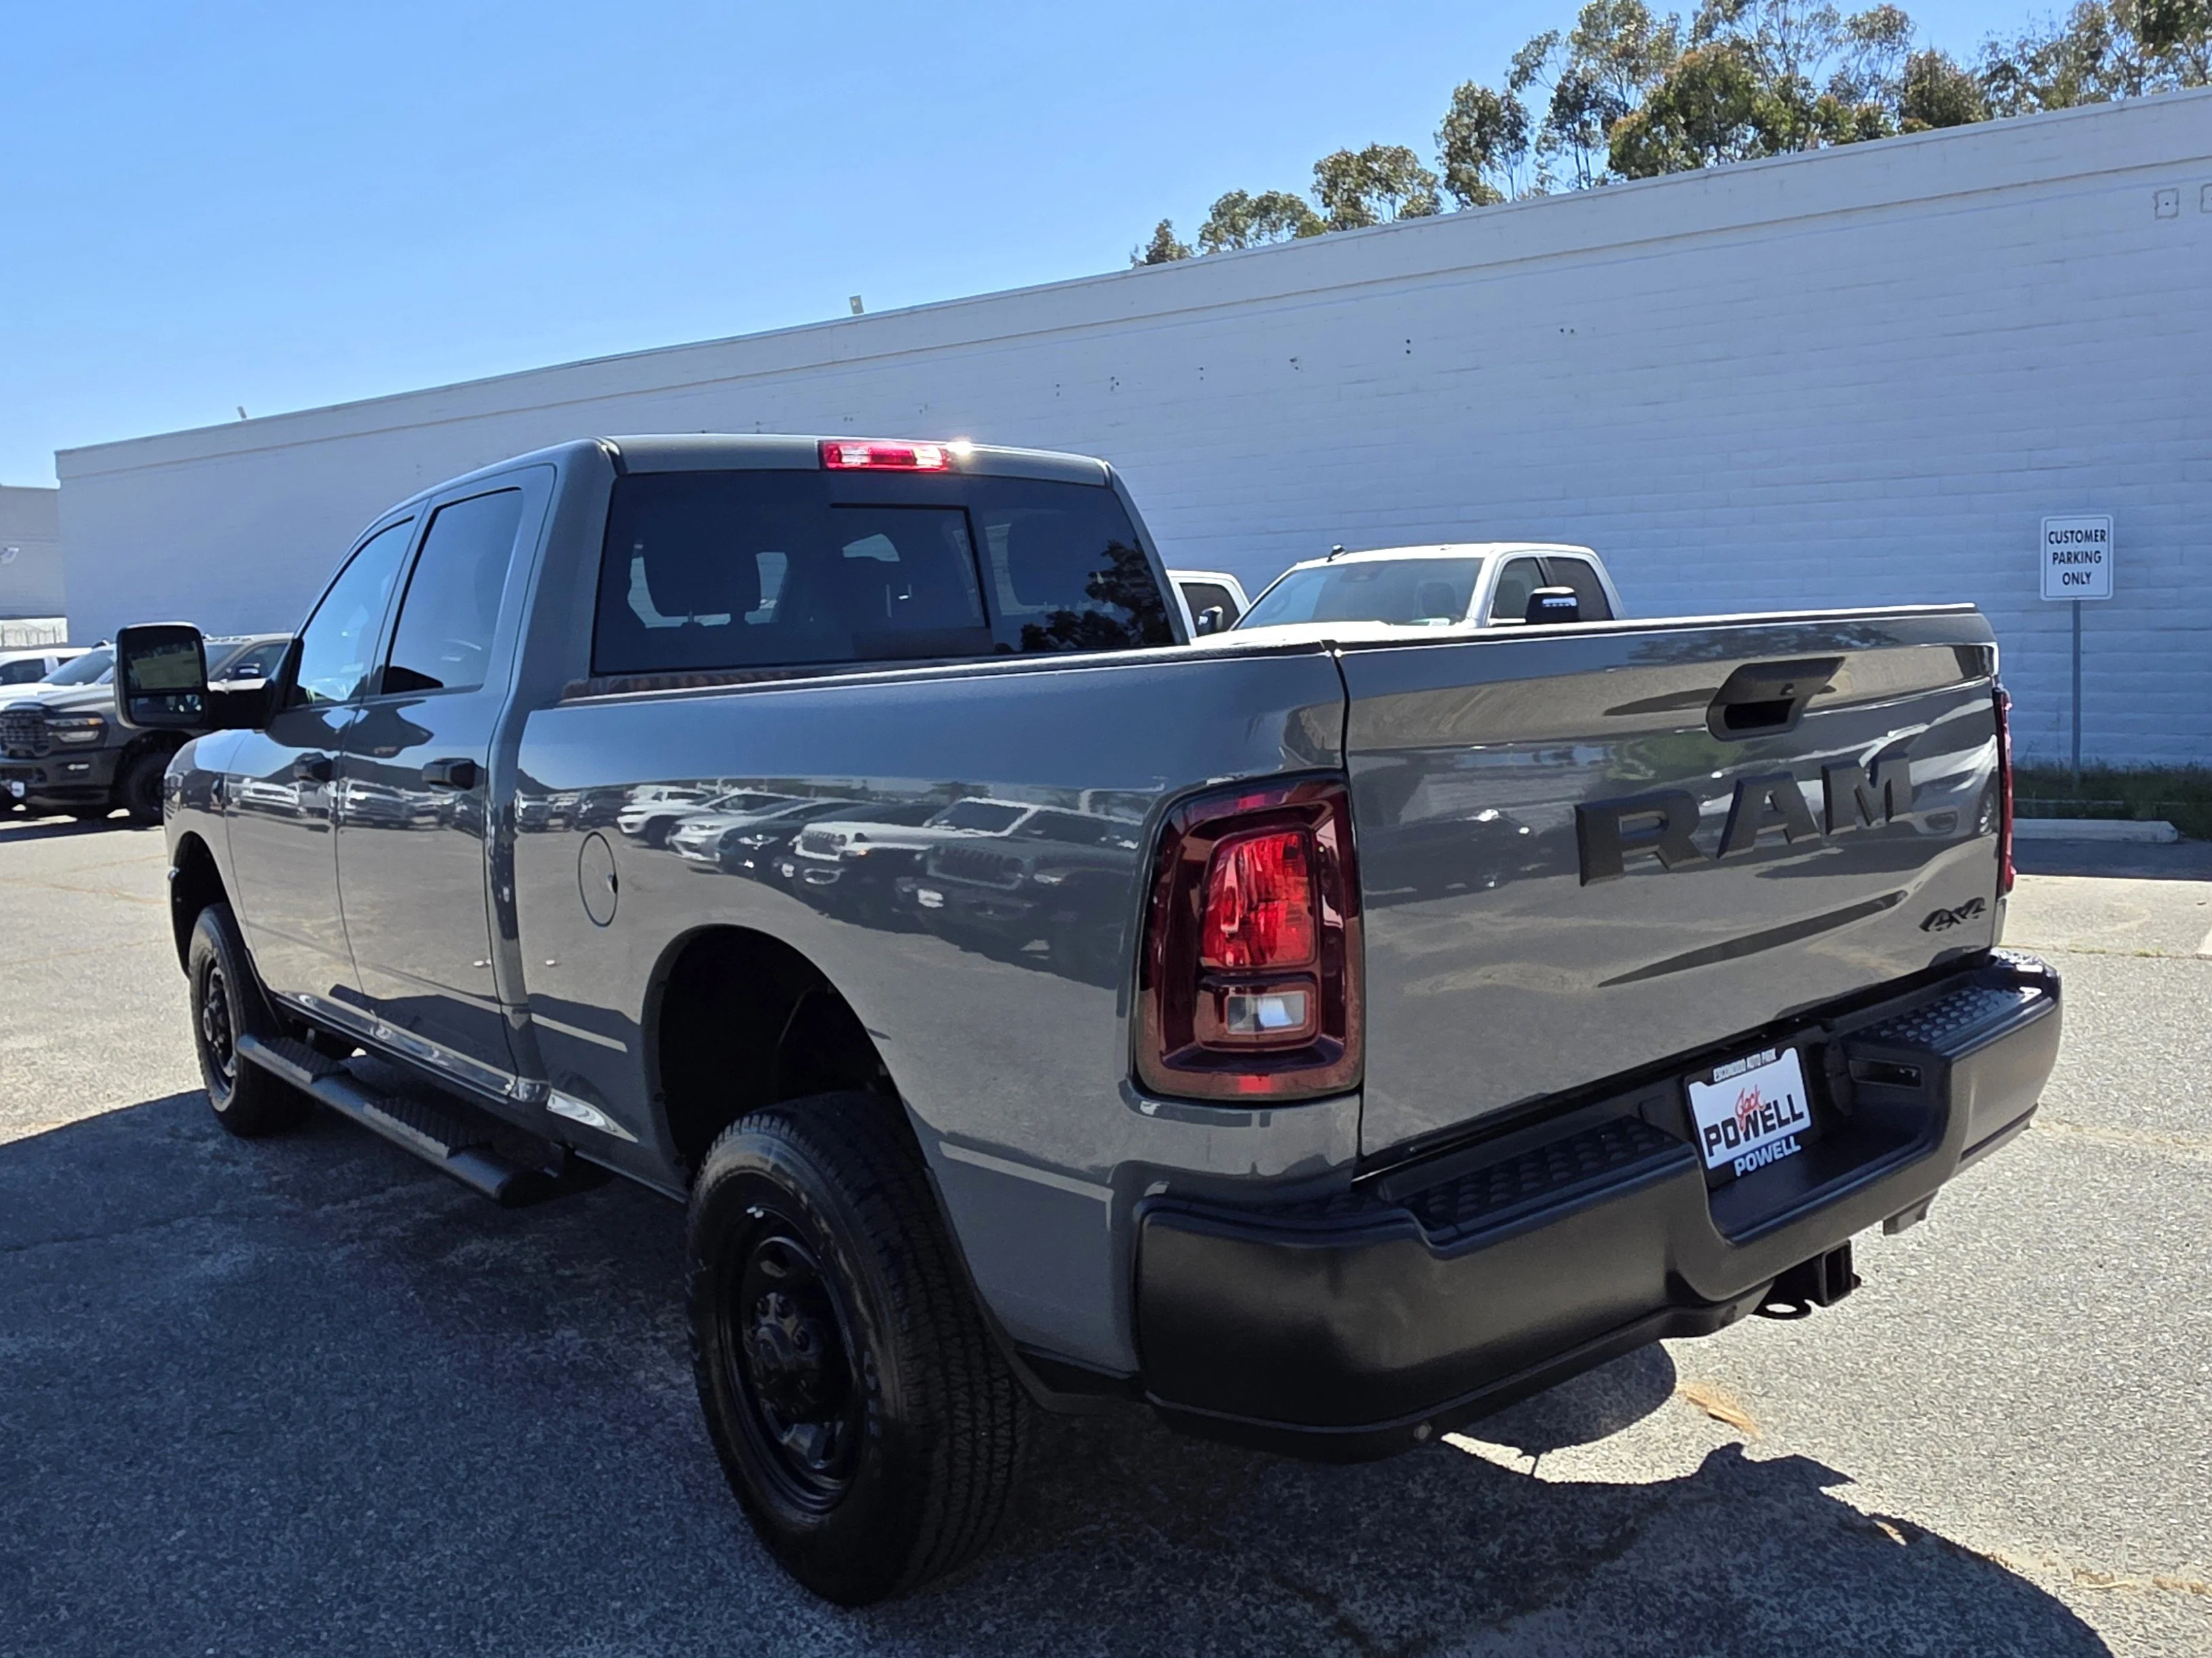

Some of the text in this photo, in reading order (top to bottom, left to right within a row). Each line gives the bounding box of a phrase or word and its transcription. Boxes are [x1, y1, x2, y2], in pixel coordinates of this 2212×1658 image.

[2048, 529, 2107, 545] CUSTOMER
[2052, 550, 2102, 565] PARKING
[2062, 572, 2092, 585] ONLY
[1574, 752, 1914, 887] RAM
[1703, 1094, 1805, 1158] POWELL
[1735, 1084, 1766, 1132] Jack
[1733, 1135, 1802, 1177] POWELL
